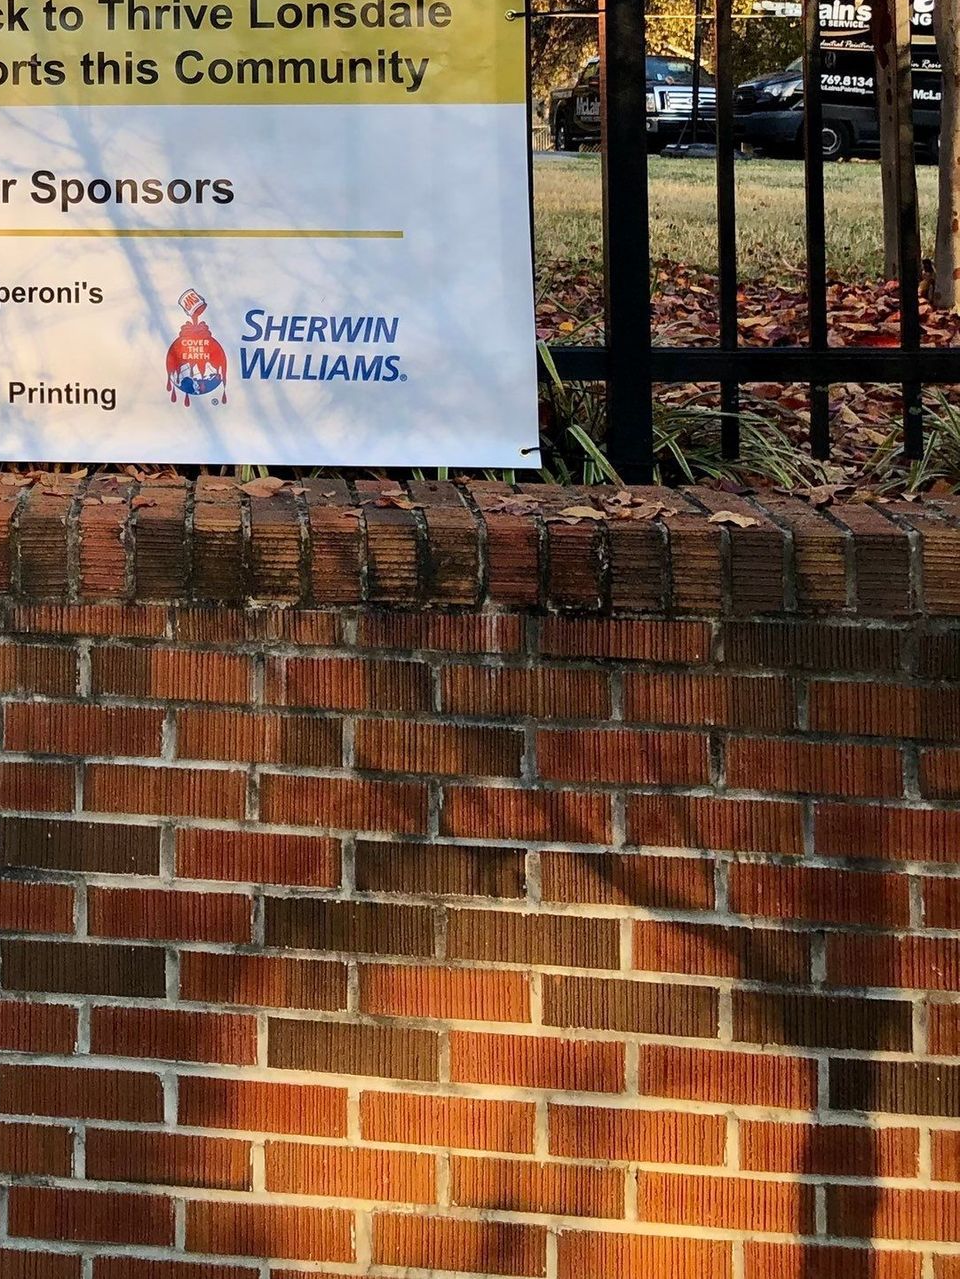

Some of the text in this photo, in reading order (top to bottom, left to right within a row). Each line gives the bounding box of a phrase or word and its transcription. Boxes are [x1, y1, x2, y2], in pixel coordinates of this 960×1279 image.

[43, 0, 84, 32] to
[80, 51, 159, 85] this
[175, 49, 430, 93] Community
[30, 169, 235, 213] Sponsors
[241, 309, 399, 344] SHERWIN
[181, 339, 210, 347] COVER
[182, 352, 211, 360] EARTH
[8, 381, 117, 410] Printing
